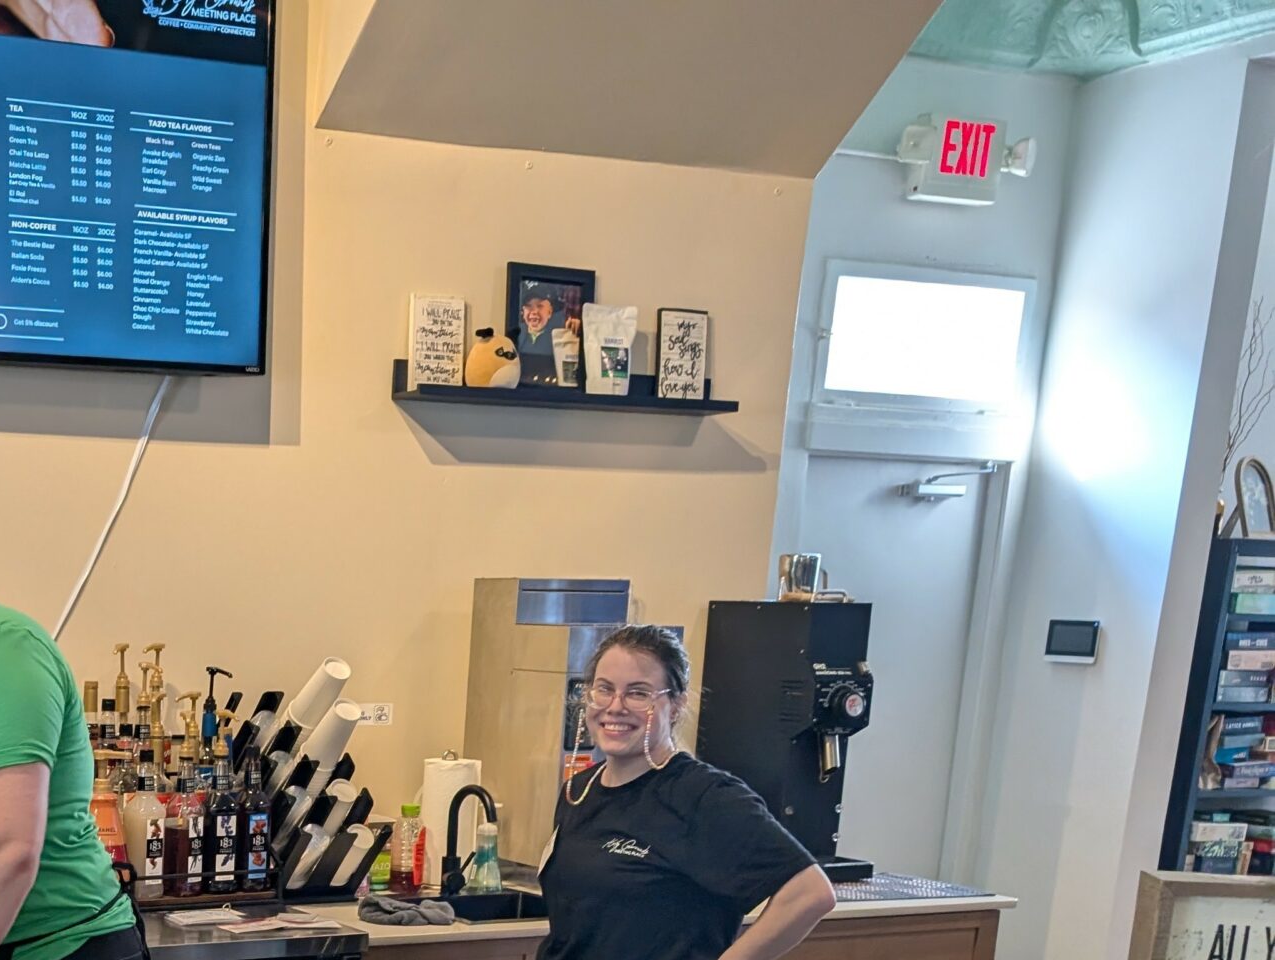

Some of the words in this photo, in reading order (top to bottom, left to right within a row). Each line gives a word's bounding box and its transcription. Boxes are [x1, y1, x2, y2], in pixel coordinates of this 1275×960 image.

[192, 8, 228, 20] MEETING
[230, 14, 256, 24] PLACE
[159, 19, 179, 27] COFFEE
[184, 22, 216, 32] COMMUNITY
[221, 27, 255, 36] CONNECTION
[9, 104, 23, 113] TEA
[148, 119, 166, 128] TAZO
[168, 121, 180, 129] TEA
[181, 122, 212, 133] FLAVORS
[162, 138, 174, 146] Teas
[191, 141, 207, 150] Green
[209, 143, 221, 151] Teas
[939, 120, 996, 178] EXIT
[142, 157, 168, 166] Breakfast
[192, 184, 212, 193] Orange
[138, 210, 174, 221] AVAILABLE
[175, 214, 197, 224] SYRUP
[198, 215, 228, 225] FLAVORS
[12, 221, 57, 231] NON-COFFEE
[133, 269, 155, 277] Almond
[187, 290, 204, 299] Honey
[663, 358, 683, 378] how
[660, 377, 682, 398] love
[680, 383, 699, 400] you
